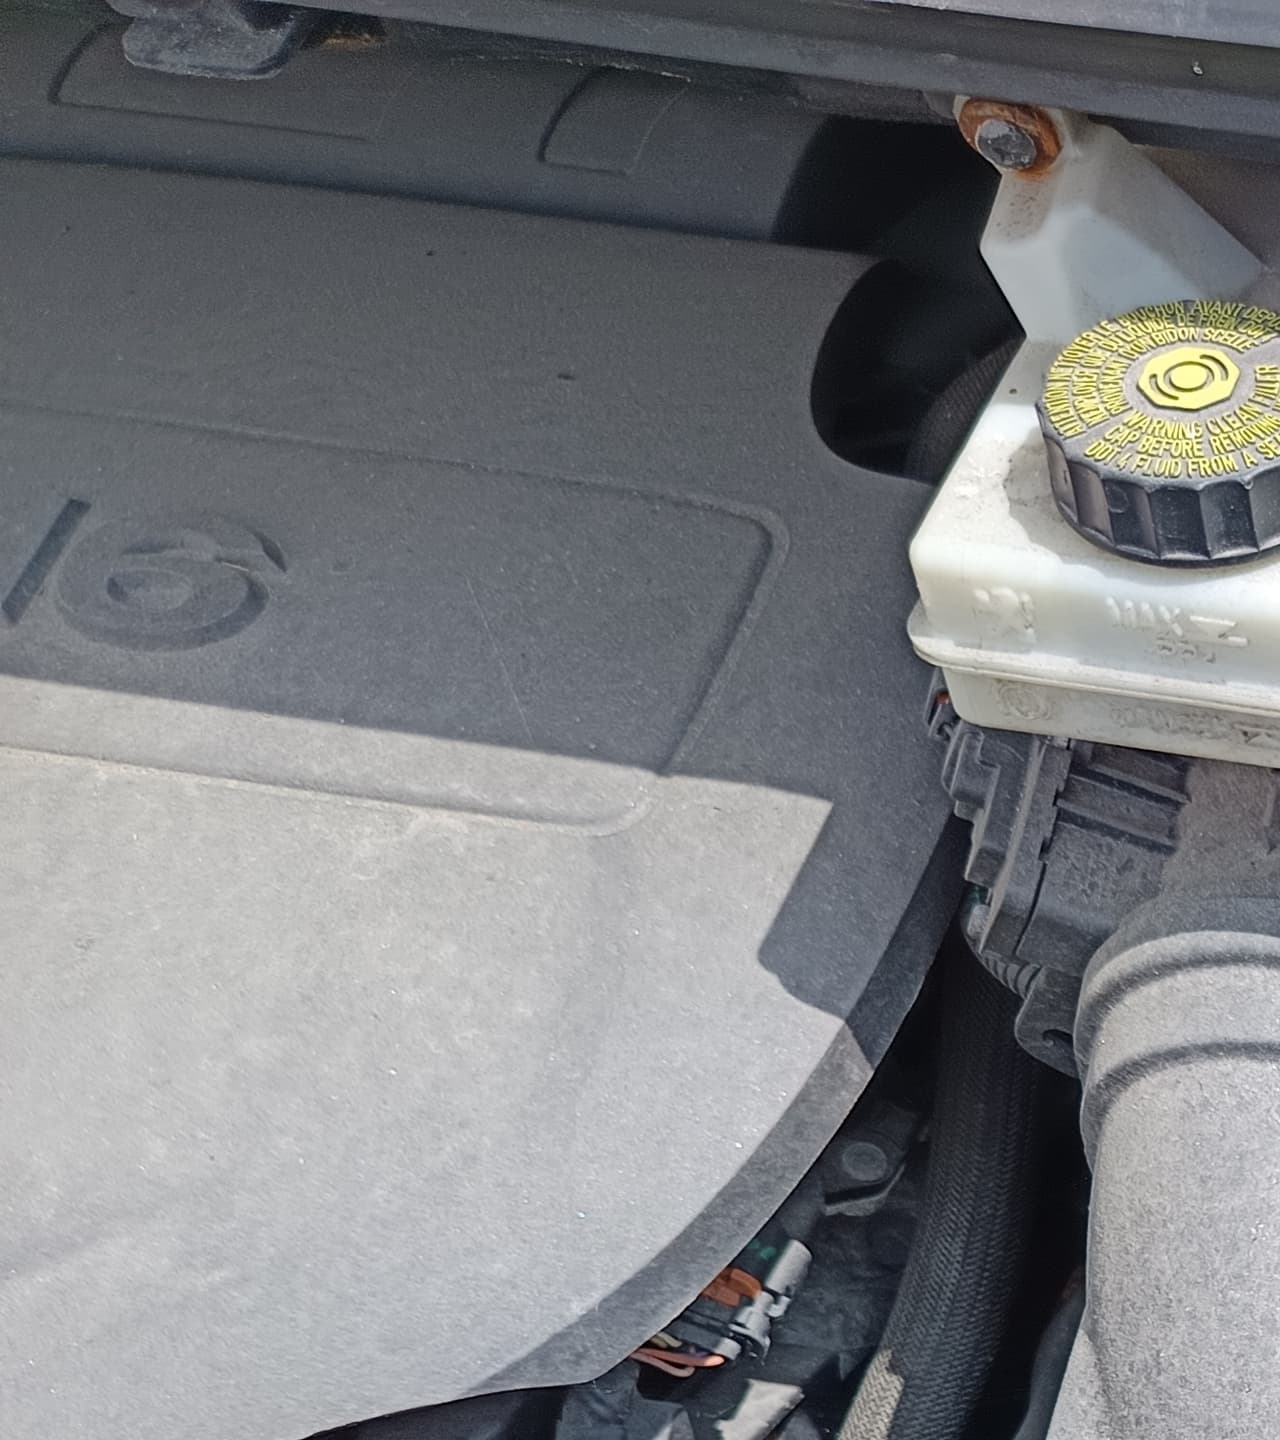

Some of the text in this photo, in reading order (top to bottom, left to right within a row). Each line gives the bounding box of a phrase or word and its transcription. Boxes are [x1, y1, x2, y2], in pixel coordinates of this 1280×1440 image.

[1176, 313, 1197, 326] DE
[1199, 313, 1238, 331] FREIN
[1190, 299, 1246, 318] AVANT
[1151, 326, 1200, 347] BIDON
[1203, 327, 1260, 354] SCELLE
[1123, 365, 1280, 440] WARNING CLEAN FILLER
[1103, 425, 1141, 449] CAP
[1137, 435, 1205, 459] BEFORE
[1084, 441, 1123, 465] DOT
[1116, 453, 1132, 470] 4
[1131, 454, 1183, 479] FLUID
[1187, 455, 1240, 479] FROM
[1240, 449, 1259, 469] A
